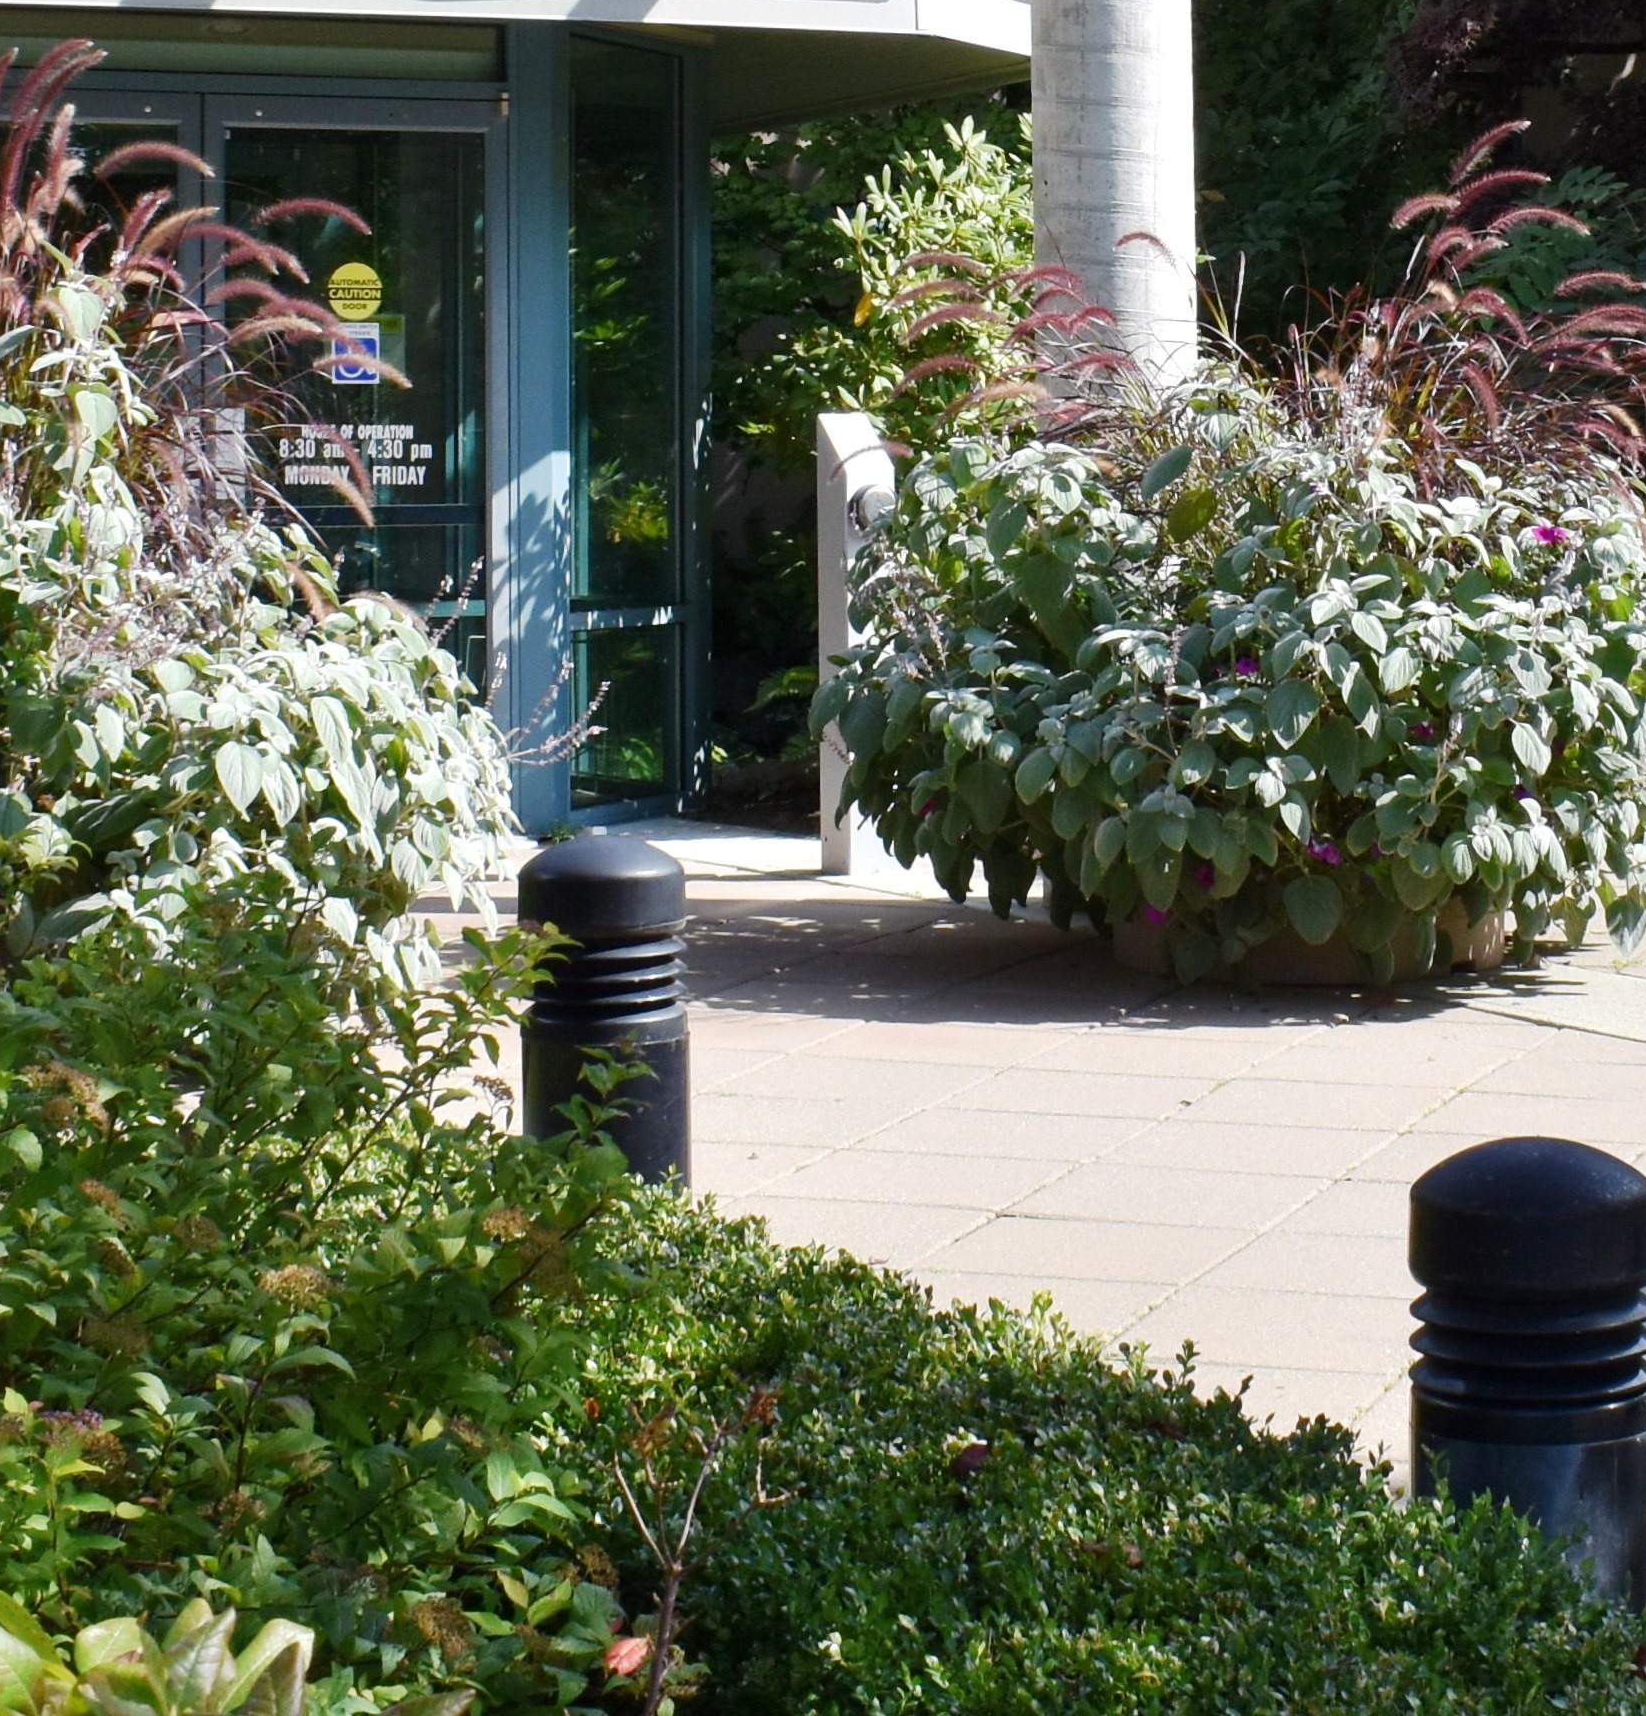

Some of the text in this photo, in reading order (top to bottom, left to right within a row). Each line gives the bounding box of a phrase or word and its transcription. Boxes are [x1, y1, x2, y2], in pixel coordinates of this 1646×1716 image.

[329, 289, 381, 298] CAUTION
[301, 424, 414, 440] HOU OF OPERATION
[279, 438, 316, 459] 8:30
[323, 443, 346, 459] am
[367, 439, 403, 459] 4:30
[410, 443, 433, 462] pm
[284, 465, 427, 485] MONDAY FRIDAY
